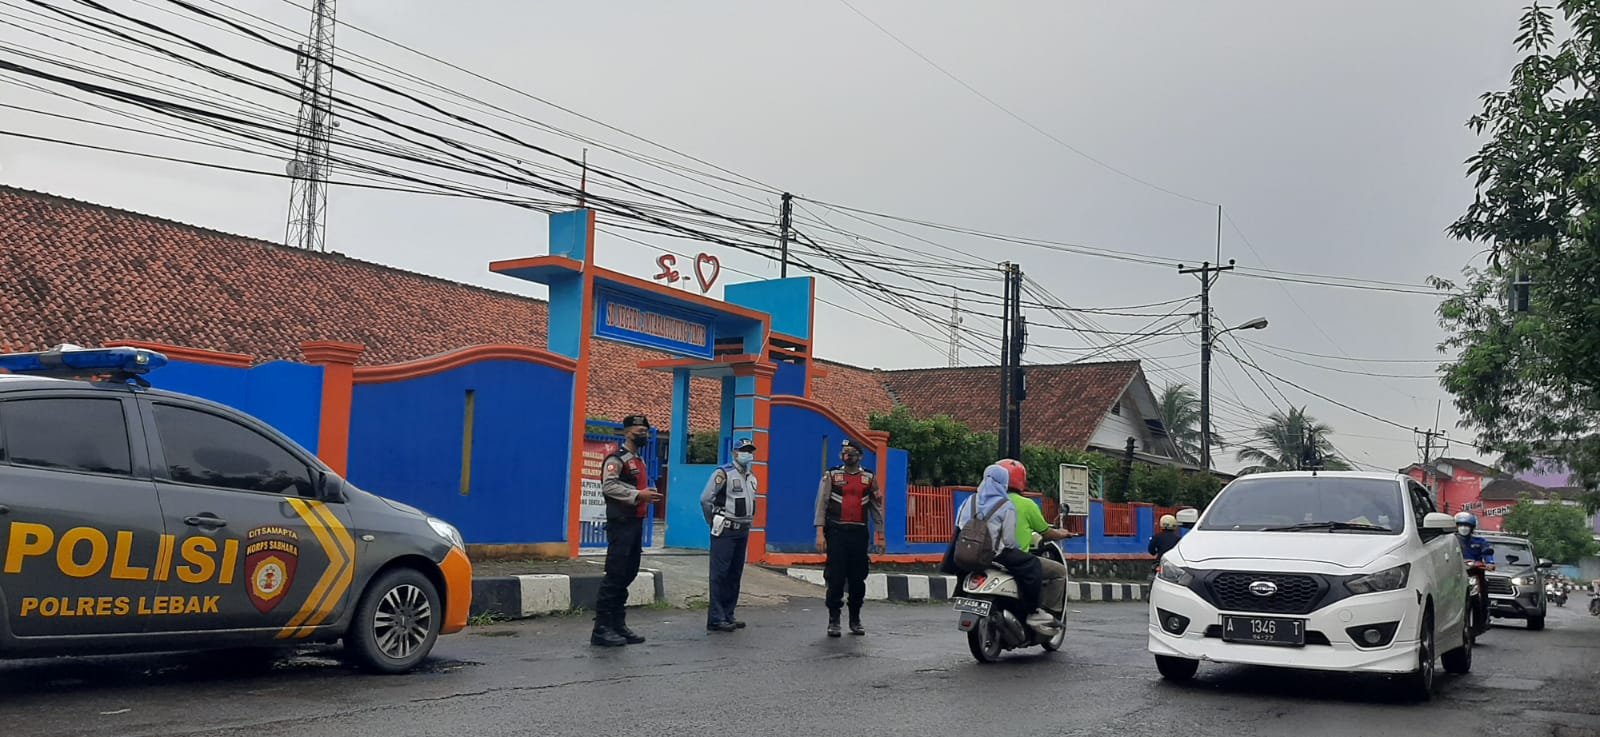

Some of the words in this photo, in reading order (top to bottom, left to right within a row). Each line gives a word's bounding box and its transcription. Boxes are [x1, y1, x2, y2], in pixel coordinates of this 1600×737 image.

[4, 521, 239, 585] POLISI
[20, 596, 129, 618] POLRES
[138, 595, 221, 615] LEBAK
[1226, 618, 1234, 632] A
[1250, 619, 1276, 634] 1346
[1293, 621, 1300, 636] T
